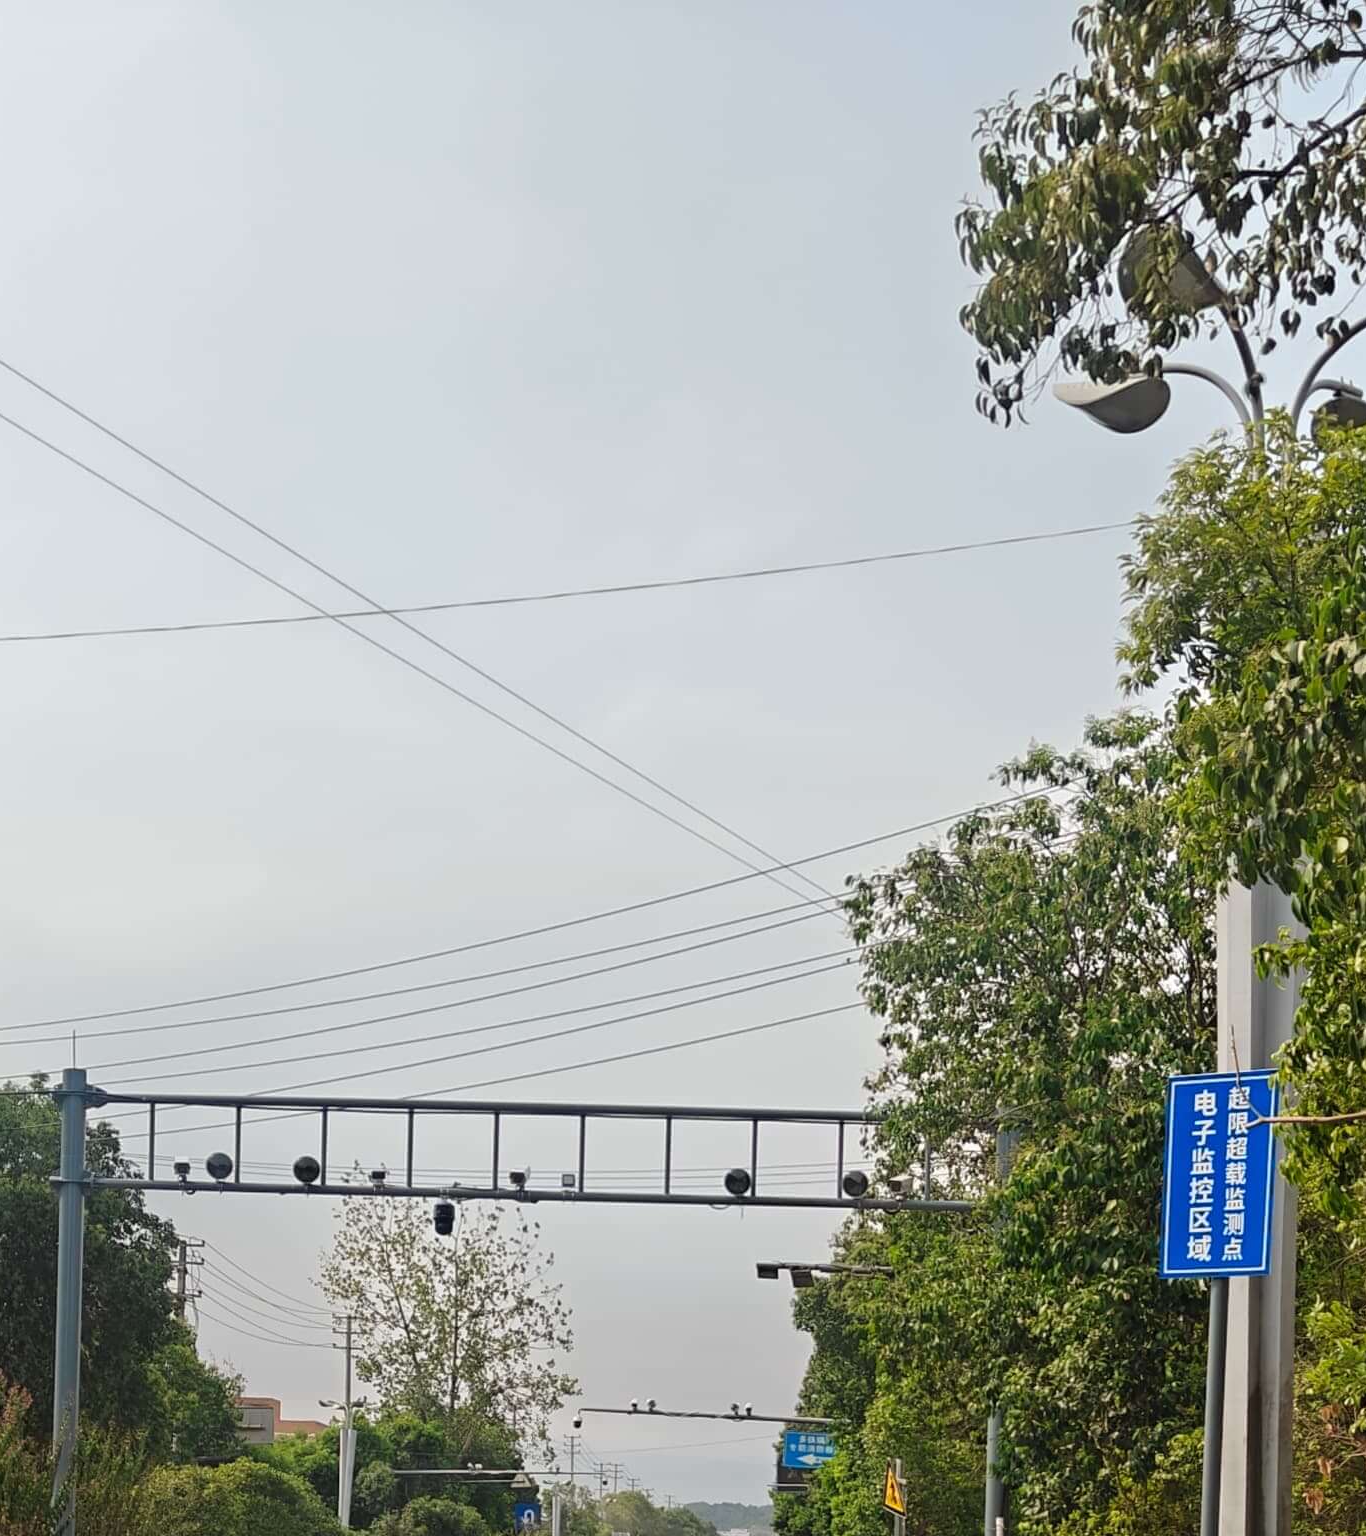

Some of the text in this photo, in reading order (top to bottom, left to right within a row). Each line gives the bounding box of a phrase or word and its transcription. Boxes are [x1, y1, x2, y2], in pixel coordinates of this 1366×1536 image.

[1187, 1089, 1218, 1261] 电子监控区域
[1221, 1085, 1251, 1261] 超限超载监测点
